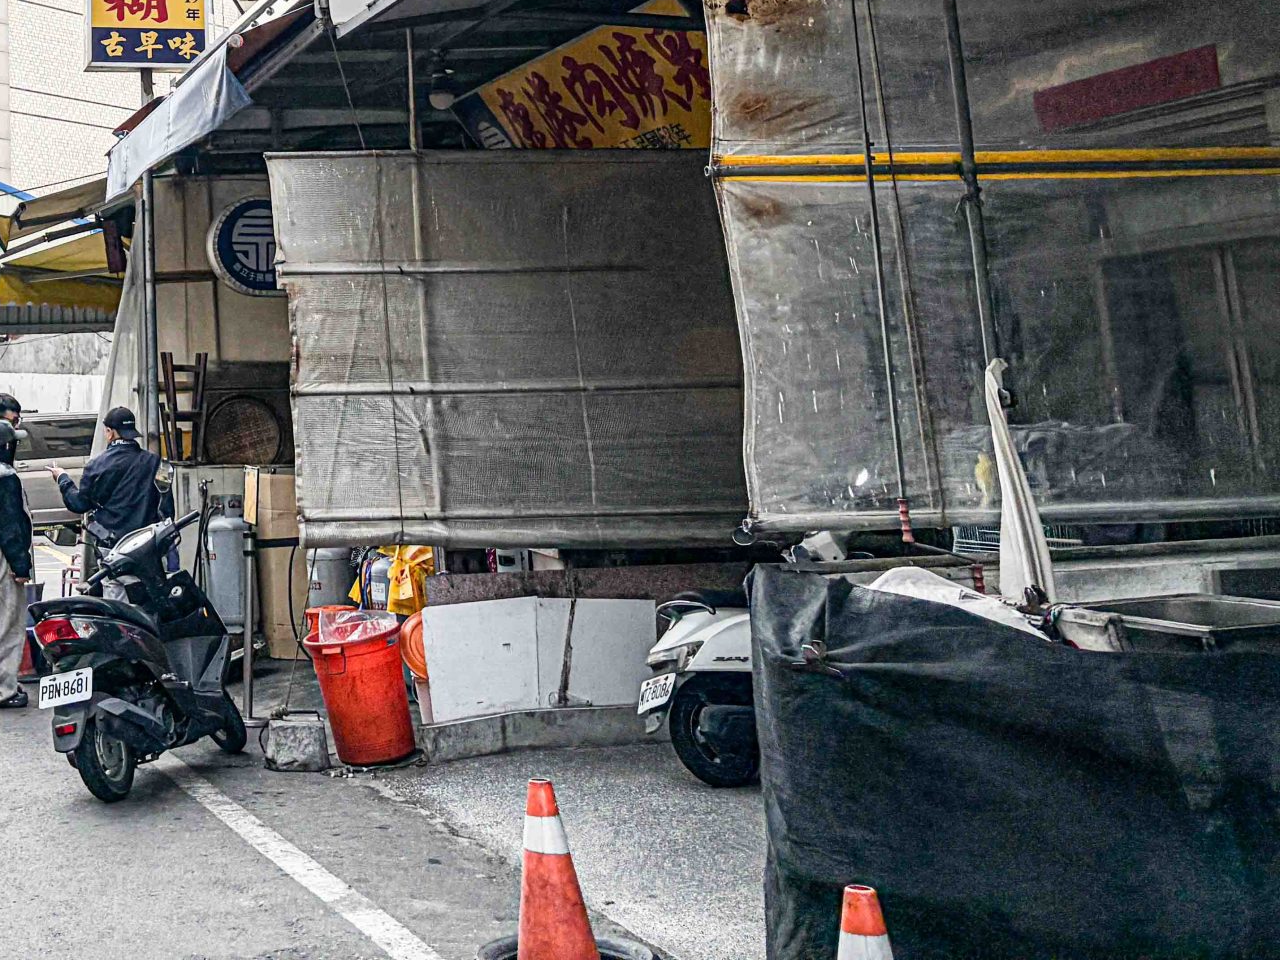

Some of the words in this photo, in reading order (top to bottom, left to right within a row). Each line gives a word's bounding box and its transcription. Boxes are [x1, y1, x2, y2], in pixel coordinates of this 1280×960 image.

[100, 31, 201, 60] 古早味
[41, 676, 88, 702] PBN-8681
